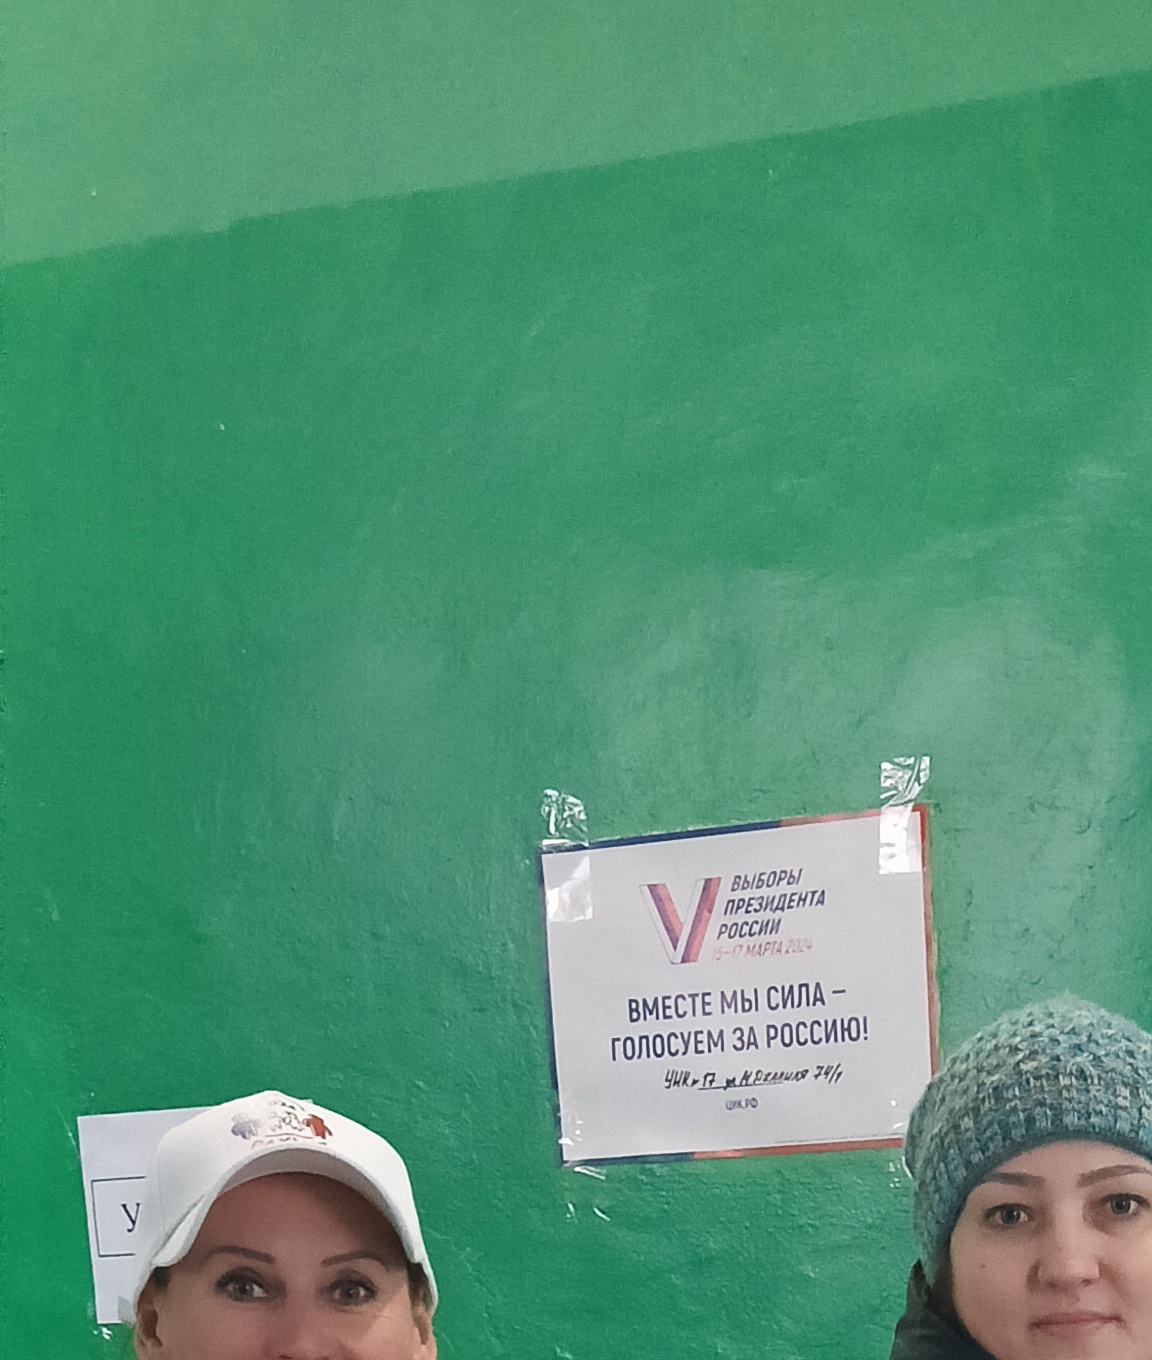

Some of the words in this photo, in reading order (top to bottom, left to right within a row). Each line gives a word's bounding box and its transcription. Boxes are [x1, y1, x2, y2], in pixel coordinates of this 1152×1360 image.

[730, 868, 803, 892] ВЫБОРЫ
[723, 889, 826, 916] ПРЕЗИДЕНТА
[716, 918, 782, 940] РОССИИ
[745, 941, 783, 957] МАРТА
[627, 991, 713, 1024] ВМЕСТЕ
[719, 988, 760, 1015] МЫ
[766, 982, 827, 1010] СИЛА
[610, 1028, 726, 1062] ГОЛОСУЕМ
[731, 1025, 760, 1052] ЗА
[765, 1016, 869, 1049] РОССИЮ!
